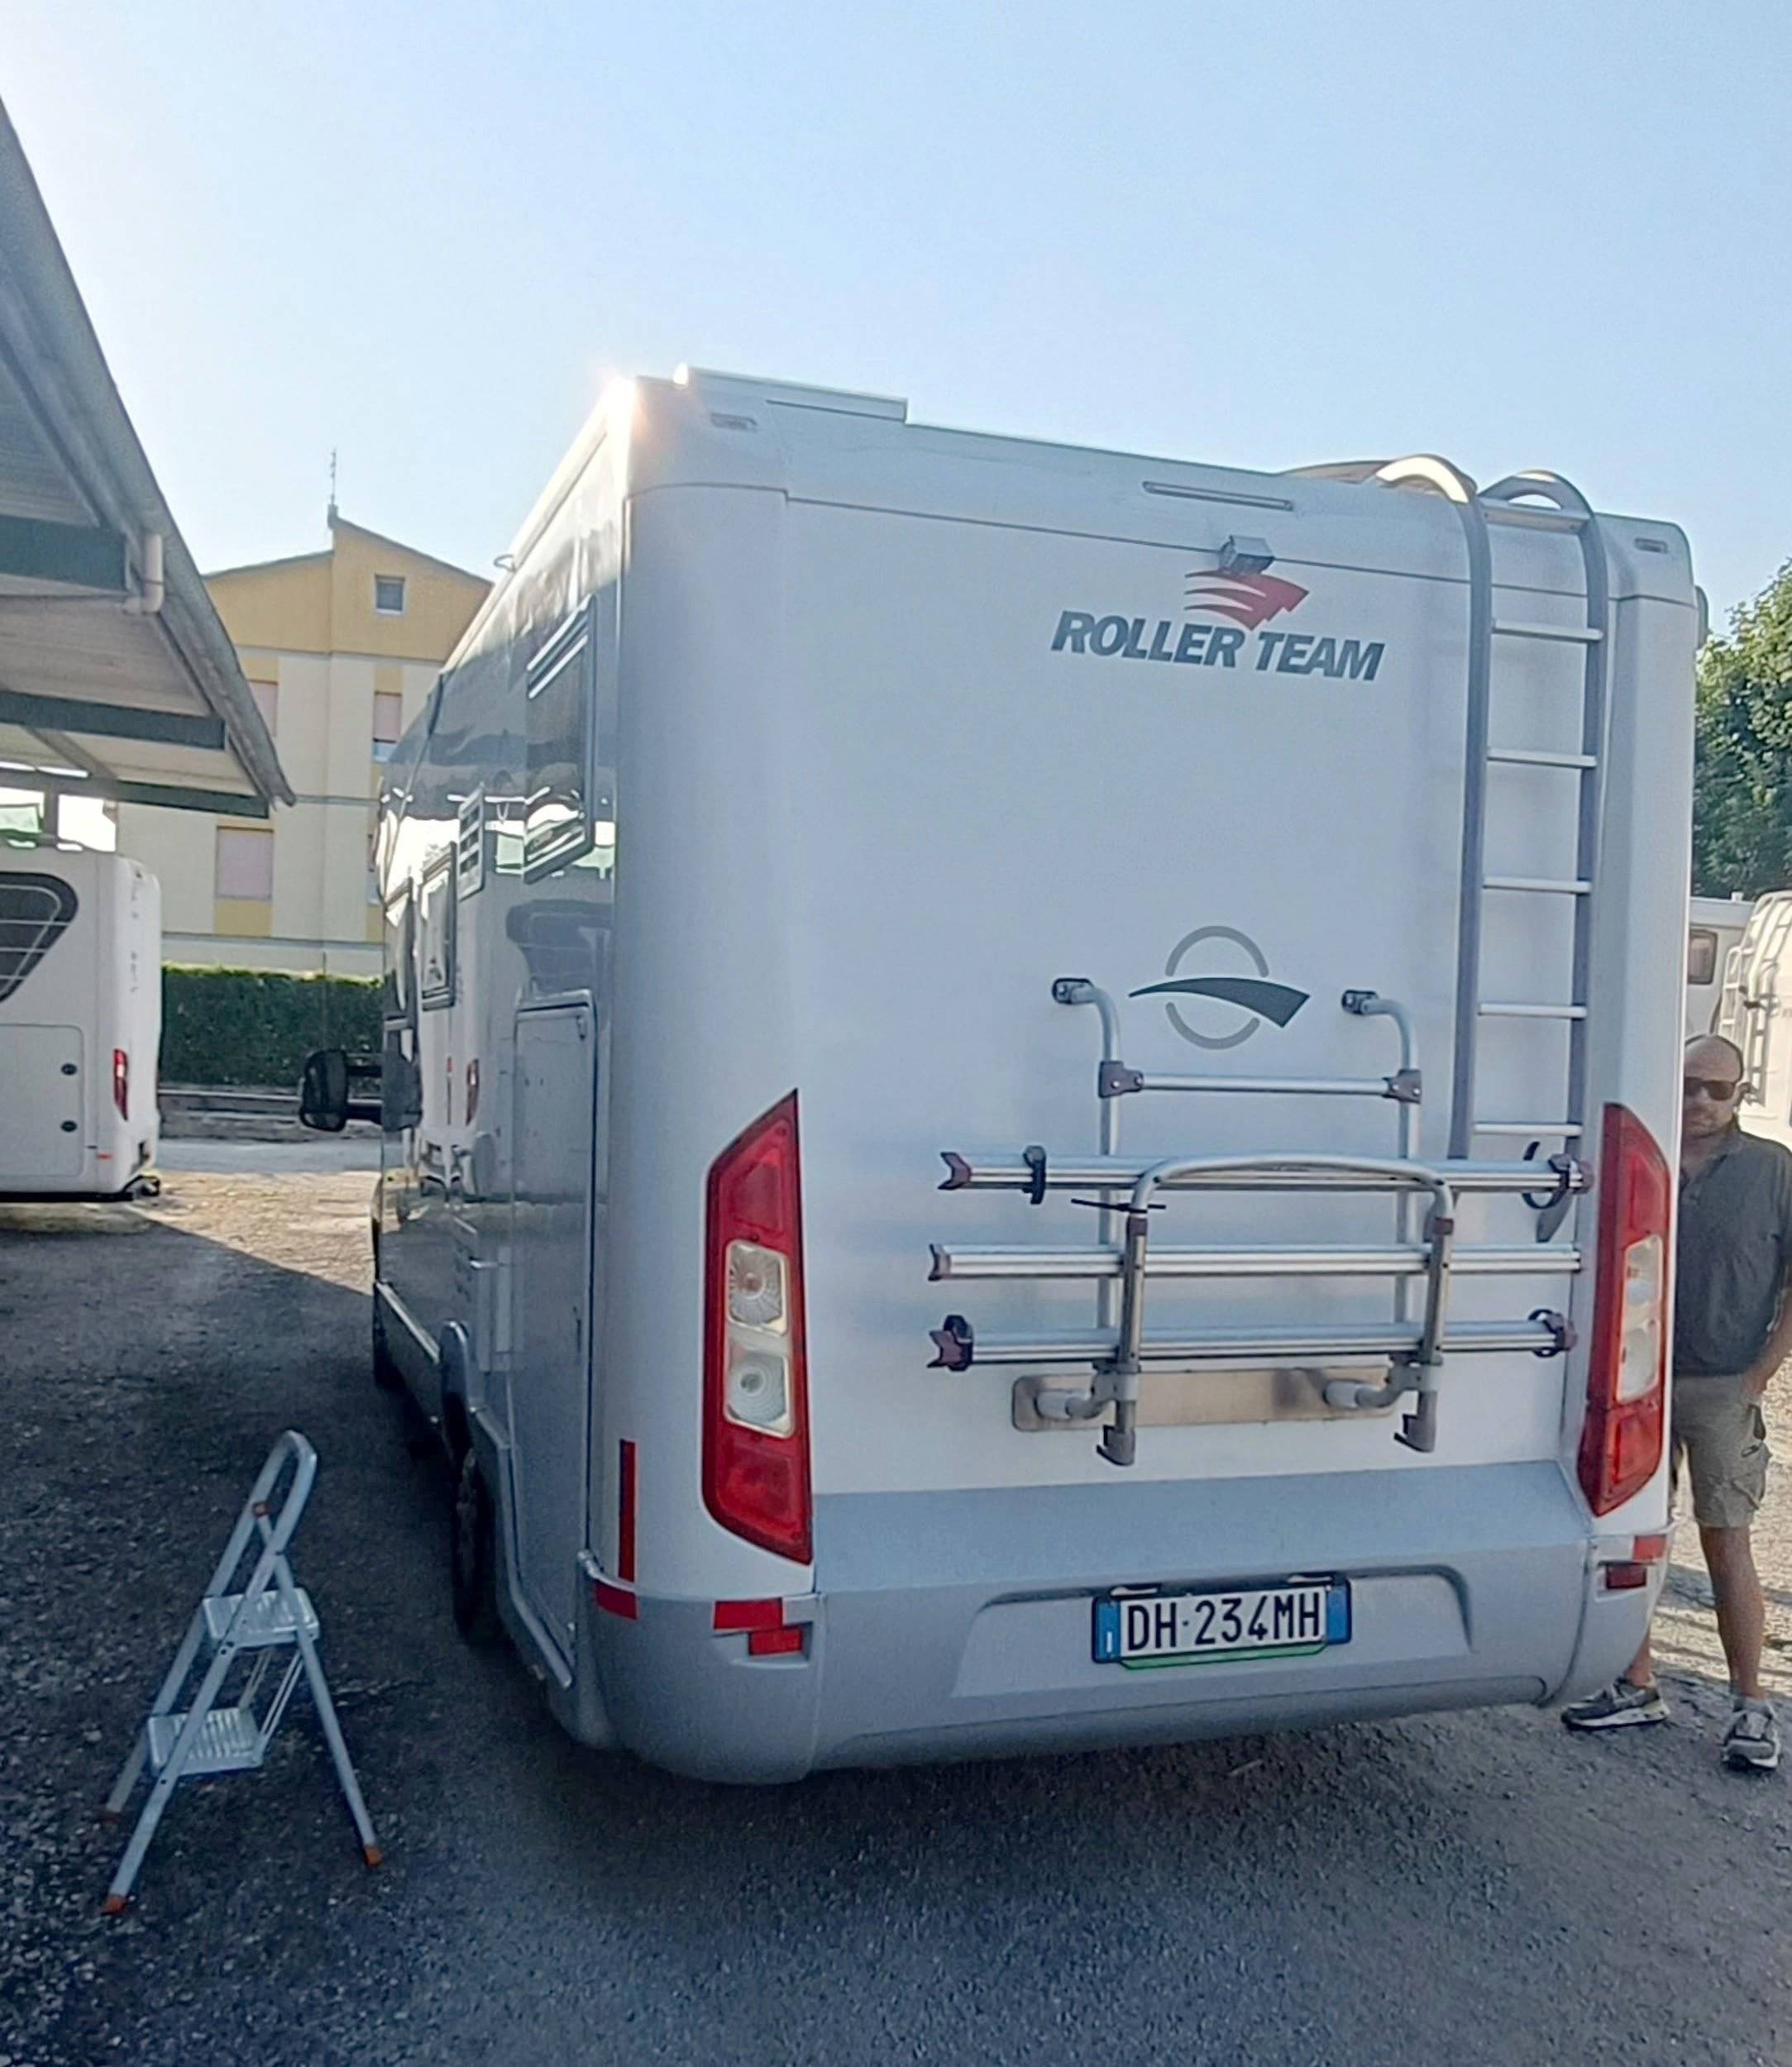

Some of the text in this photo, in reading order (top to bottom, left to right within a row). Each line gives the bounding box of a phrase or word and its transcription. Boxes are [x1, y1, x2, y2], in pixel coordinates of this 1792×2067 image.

[1051, 611, 1386, 681] ROLLER TEAM
[1128, 1592, 1320, 1650] DH 234MH
